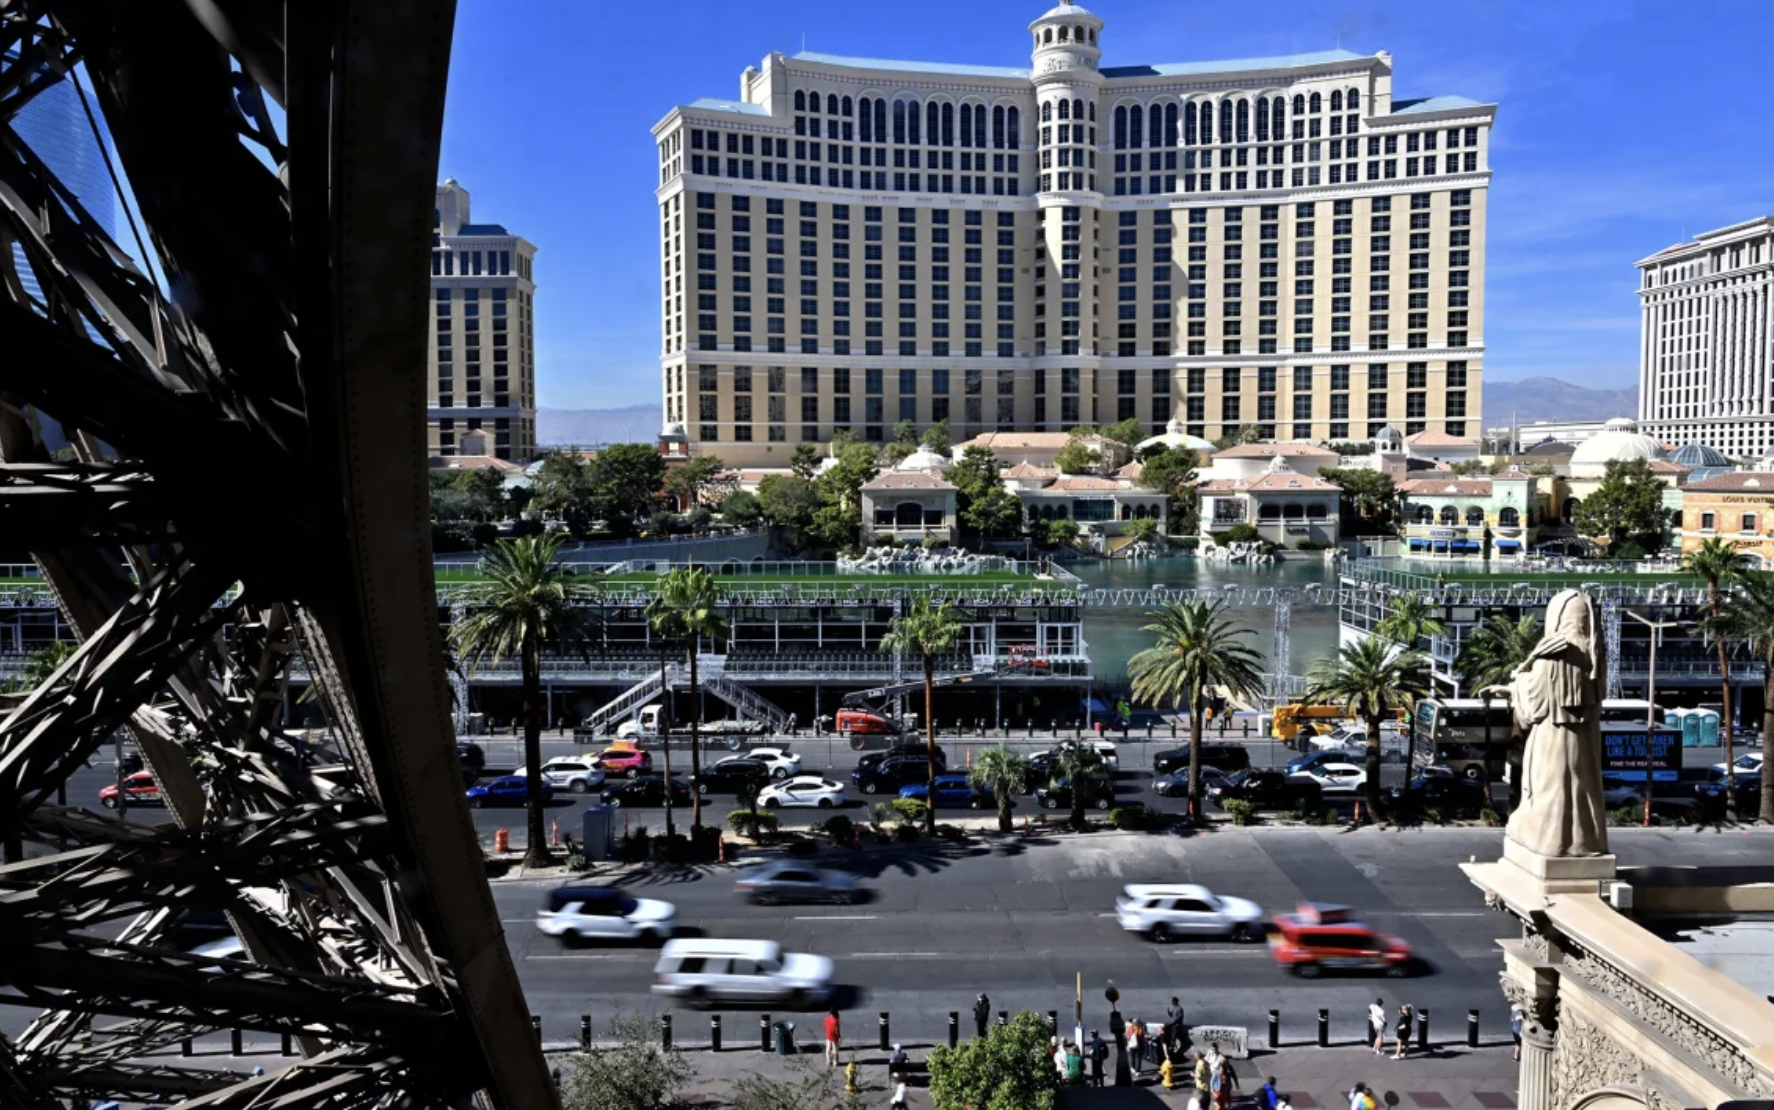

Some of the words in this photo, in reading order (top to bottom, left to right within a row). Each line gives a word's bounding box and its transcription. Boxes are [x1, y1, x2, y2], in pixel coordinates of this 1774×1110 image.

[1605, 735, 1629, 746] DON'T
[1631, 735, 1647, 746] GET
[1649, 735, 1674, 746] AKEN
[1607, 746, 1625, 757] LIKE
[1627, 746, 1633, 757] A
